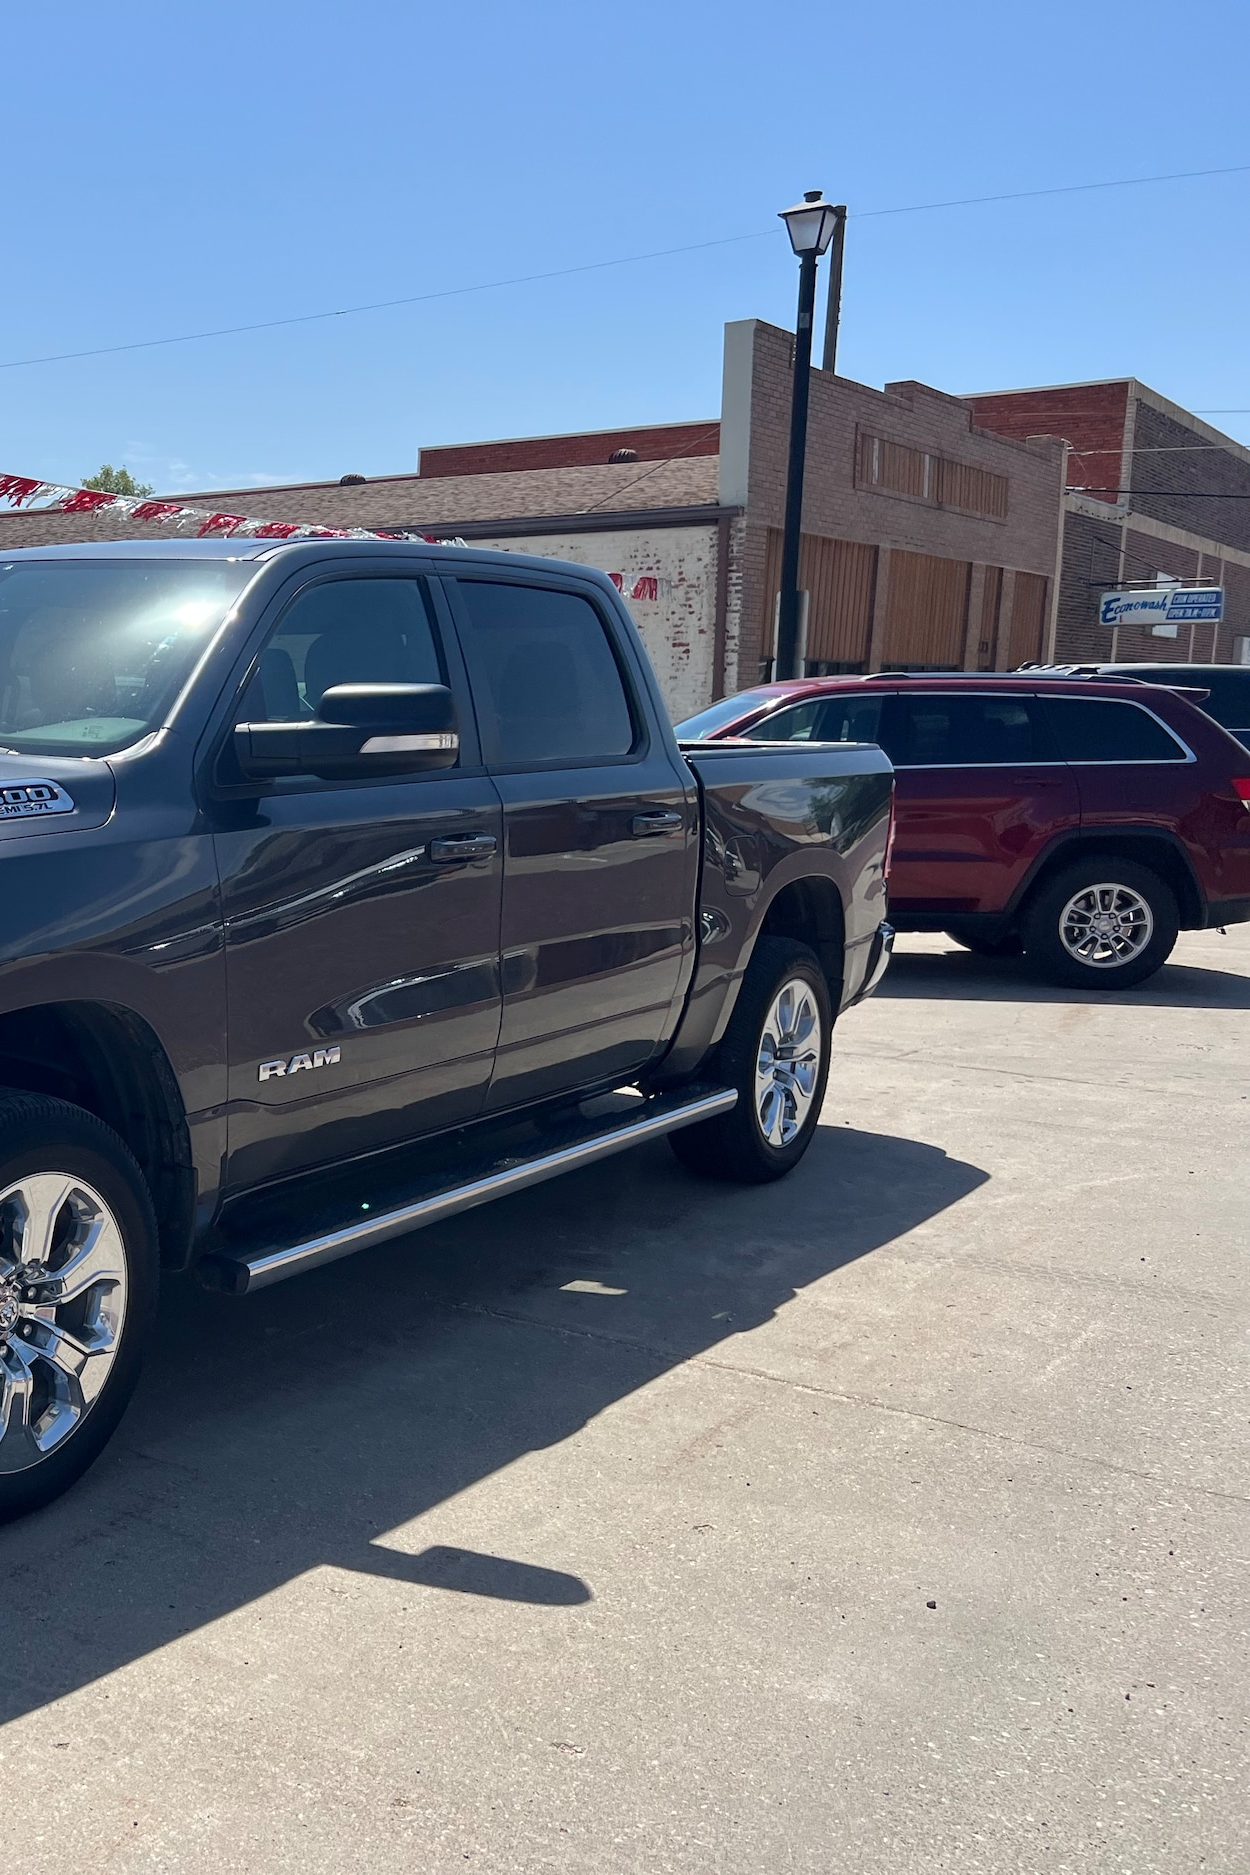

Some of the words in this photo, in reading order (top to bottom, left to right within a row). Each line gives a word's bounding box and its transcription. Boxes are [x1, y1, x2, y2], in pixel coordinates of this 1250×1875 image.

[1101, 594, 1168, 623] Econowash
[1187, 593, 1217, 604] OPERATED
[25, 802, 54, 812] 5.7L
[258, 1046, 341, 1082] RAM
